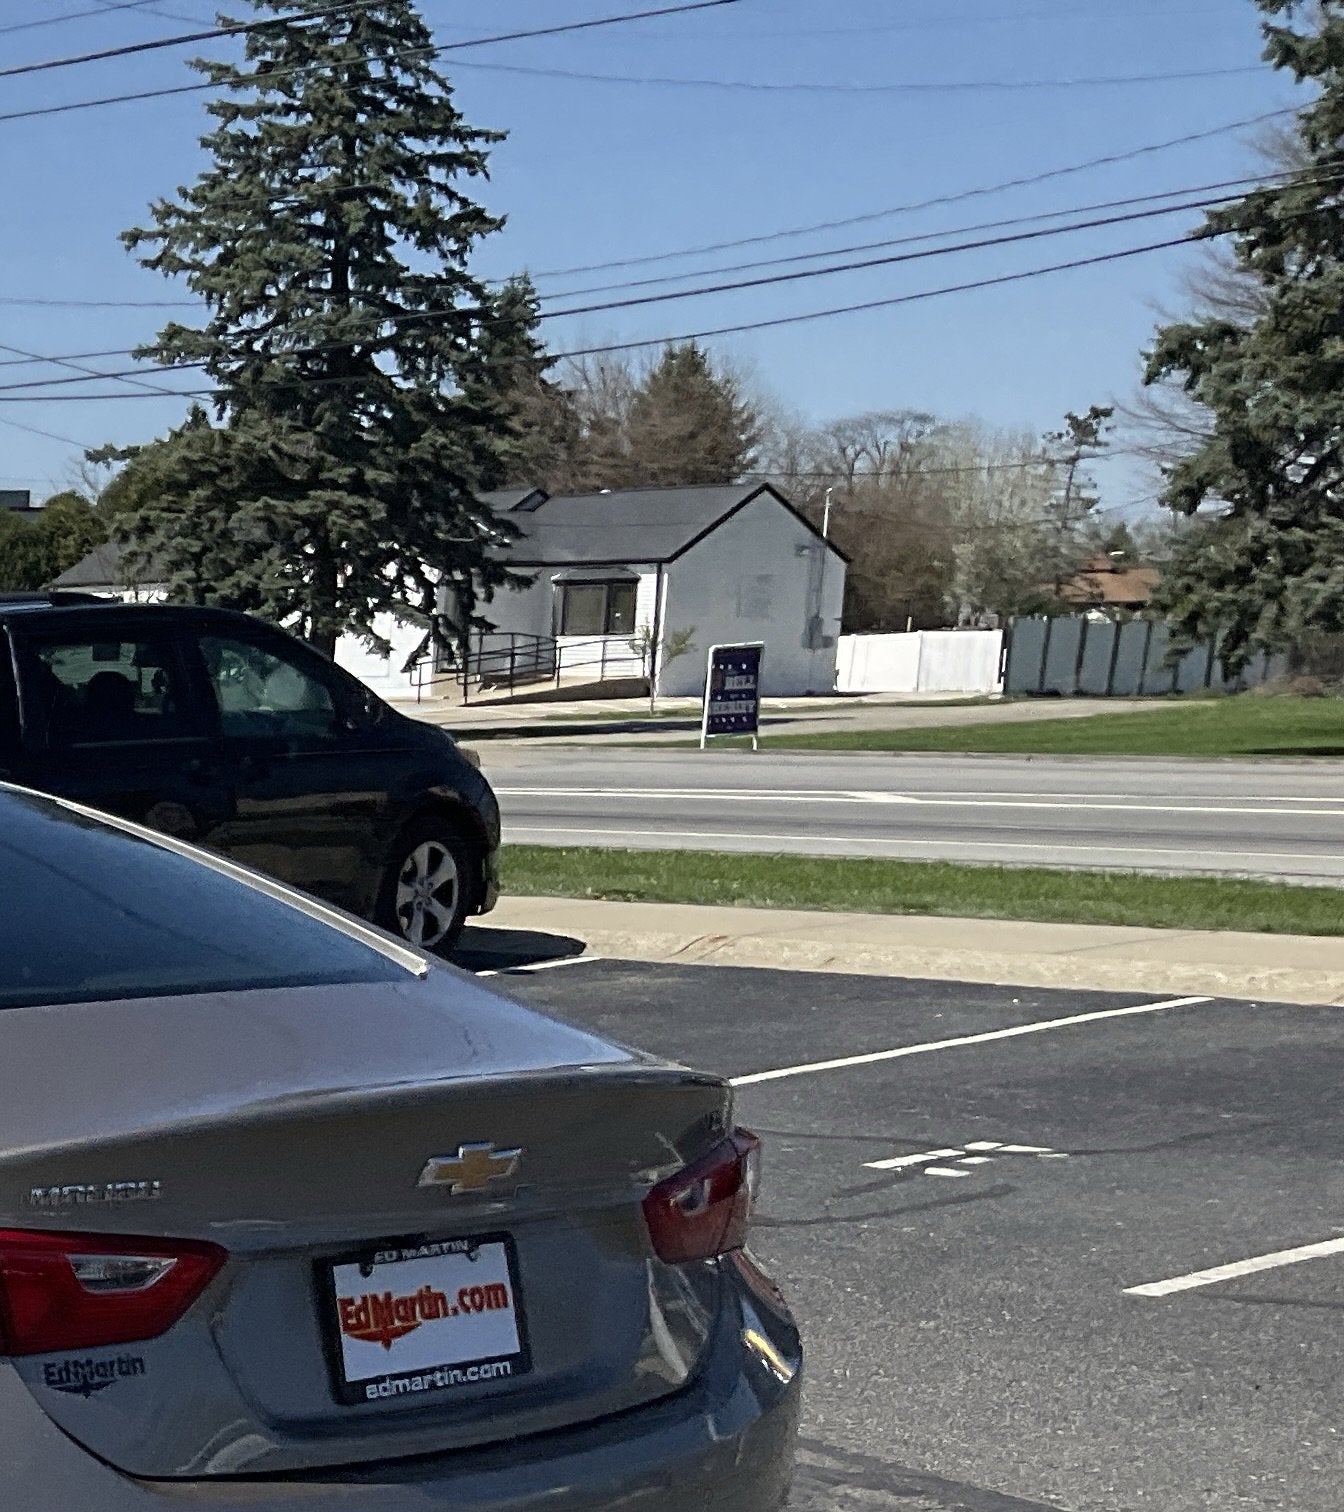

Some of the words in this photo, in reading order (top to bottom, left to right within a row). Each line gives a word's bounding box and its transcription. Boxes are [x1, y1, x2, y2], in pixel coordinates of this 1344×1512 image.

[374, 1250, 401, 1264] ED
[402, 1240, 470, 1259] MARTIN
[365, 1360, 511, 1400] edmartin.com
